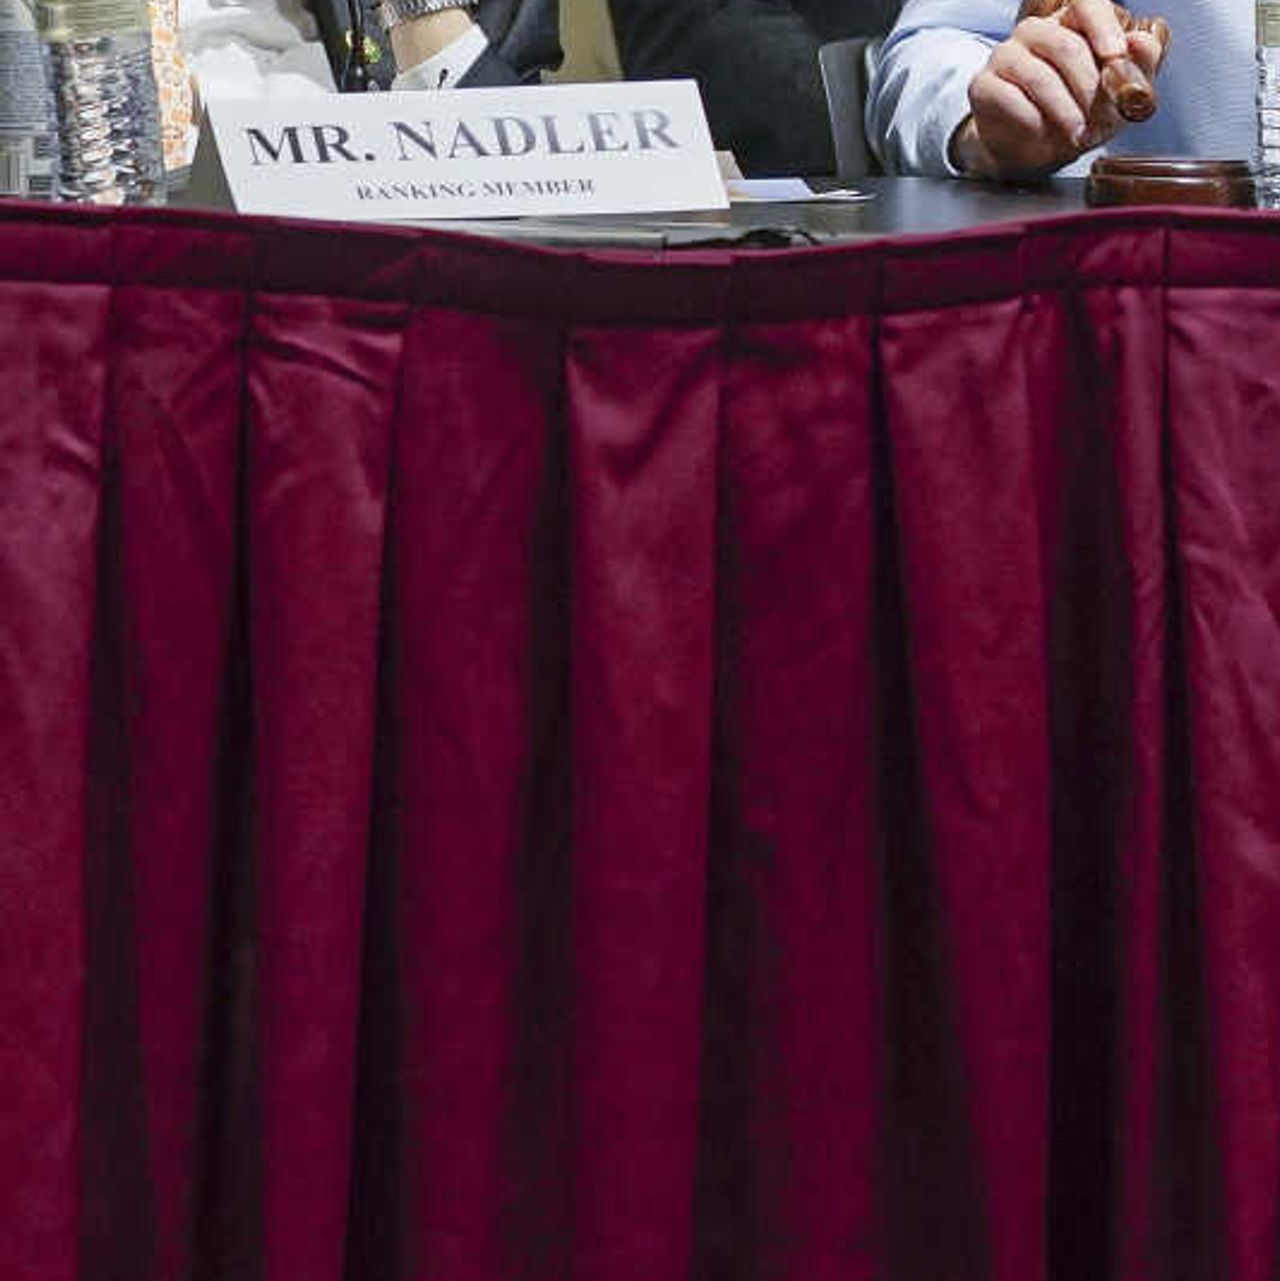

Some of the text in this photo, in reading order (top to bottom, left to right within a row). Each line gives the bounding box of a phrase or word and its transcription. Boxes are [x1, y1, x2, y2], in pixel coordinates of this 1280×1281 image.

[245, 109, 682, 167] MR. NADLER
[356, 177, 596, 201] RANKING MEMBER
